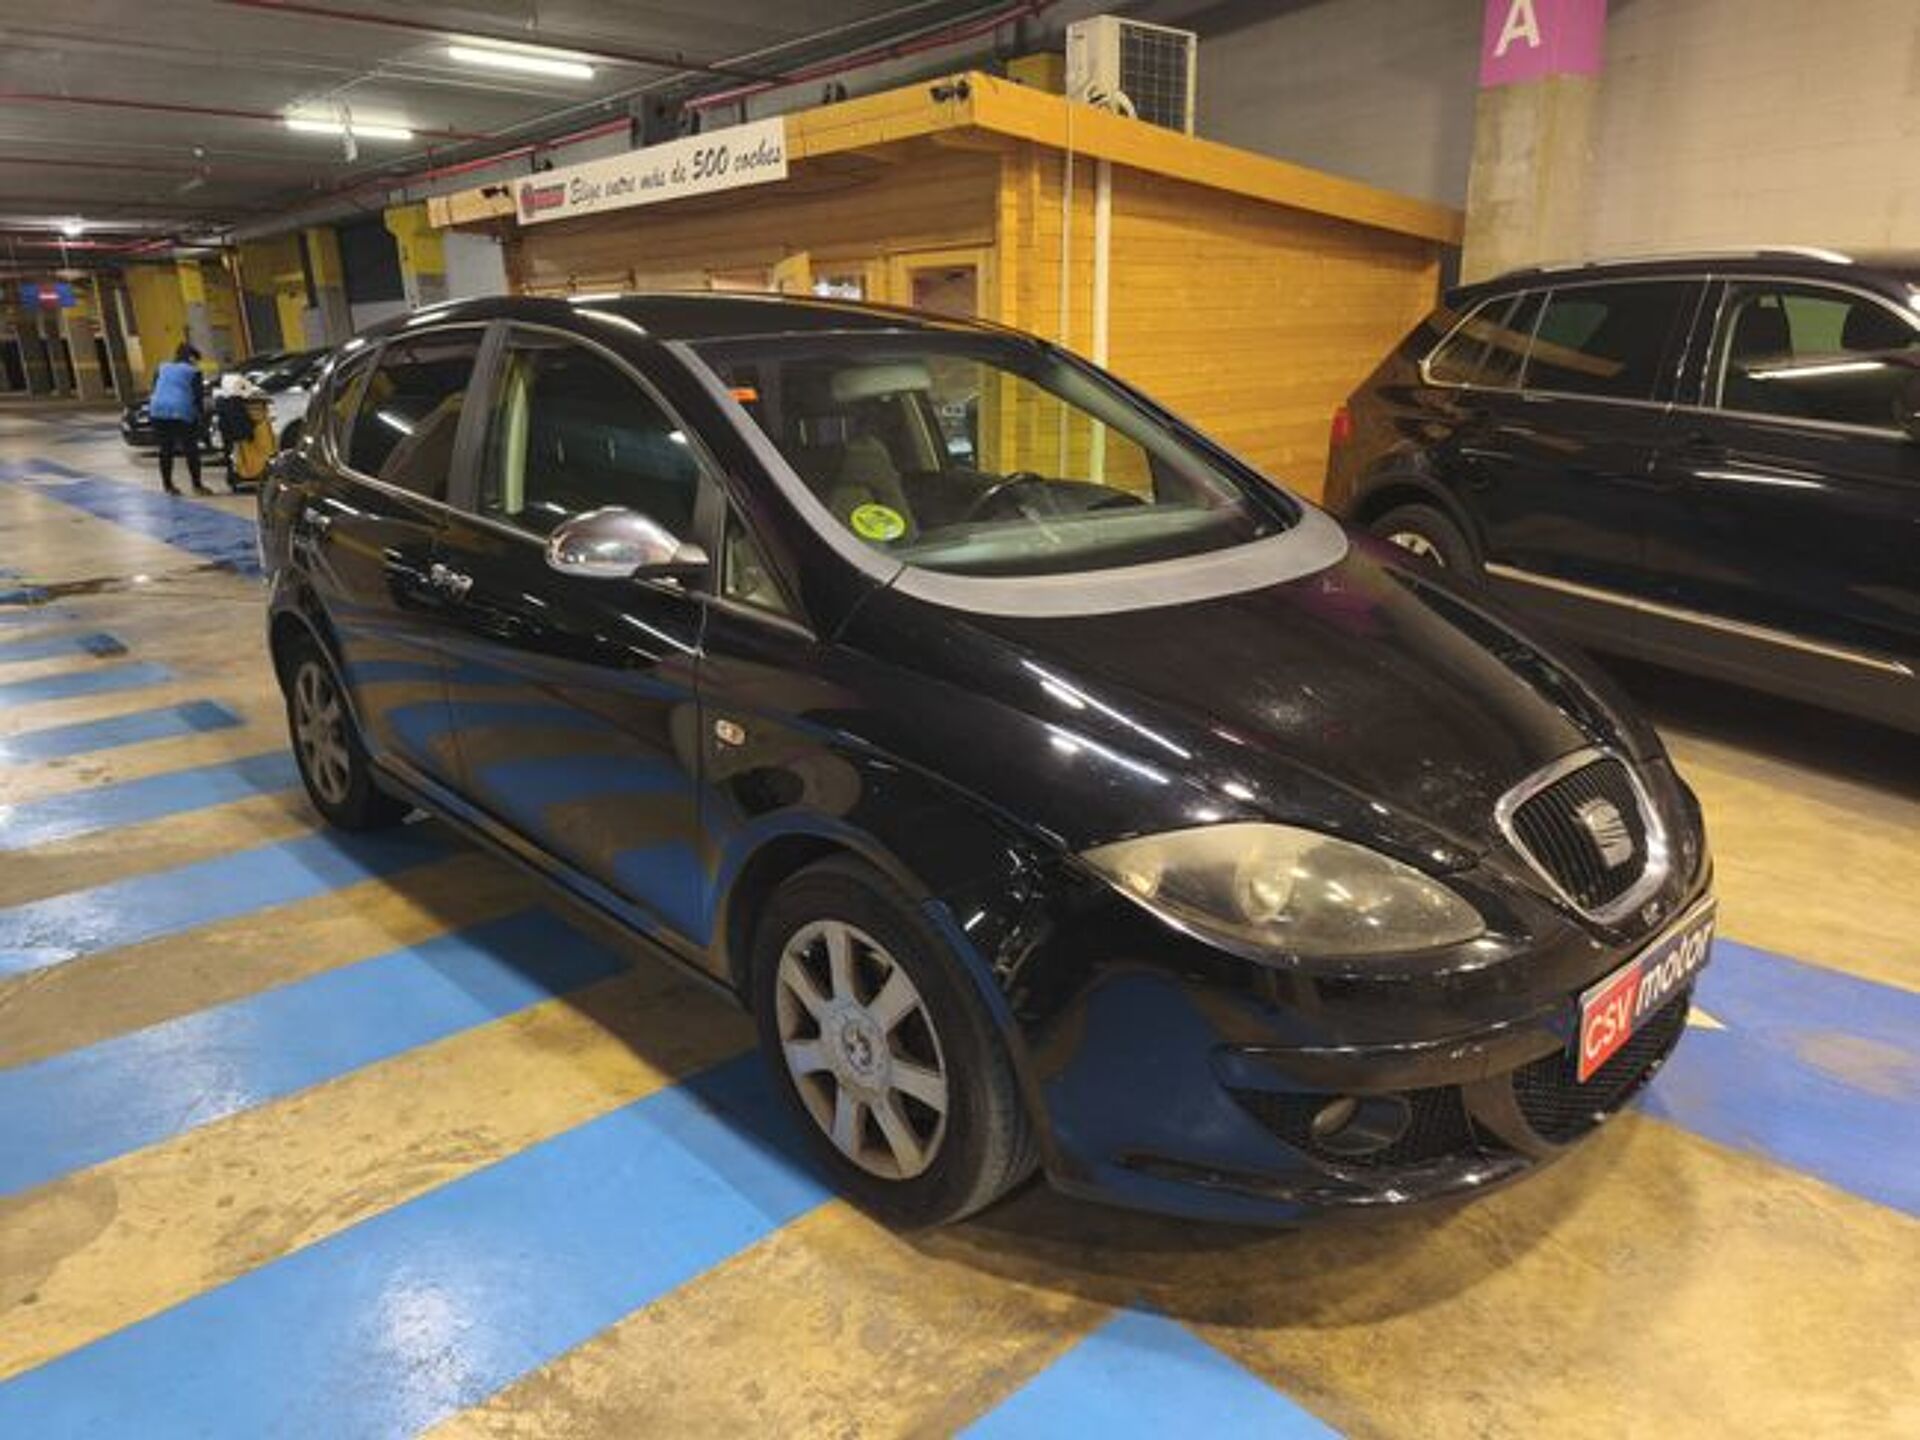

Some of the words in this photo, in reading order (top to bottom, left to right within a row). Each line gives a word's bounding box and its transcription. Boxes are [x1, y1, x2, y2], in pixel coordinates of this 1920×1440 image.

[1494, 0, 1540, 56] A
[671, 159, 686, 183] de
[693, 145, 728, 181] 500
[734, 139, 781, 172] coches
[1585, 988, 1634, 1059] CSV
[1636, 922, 1714, 1016] motor
